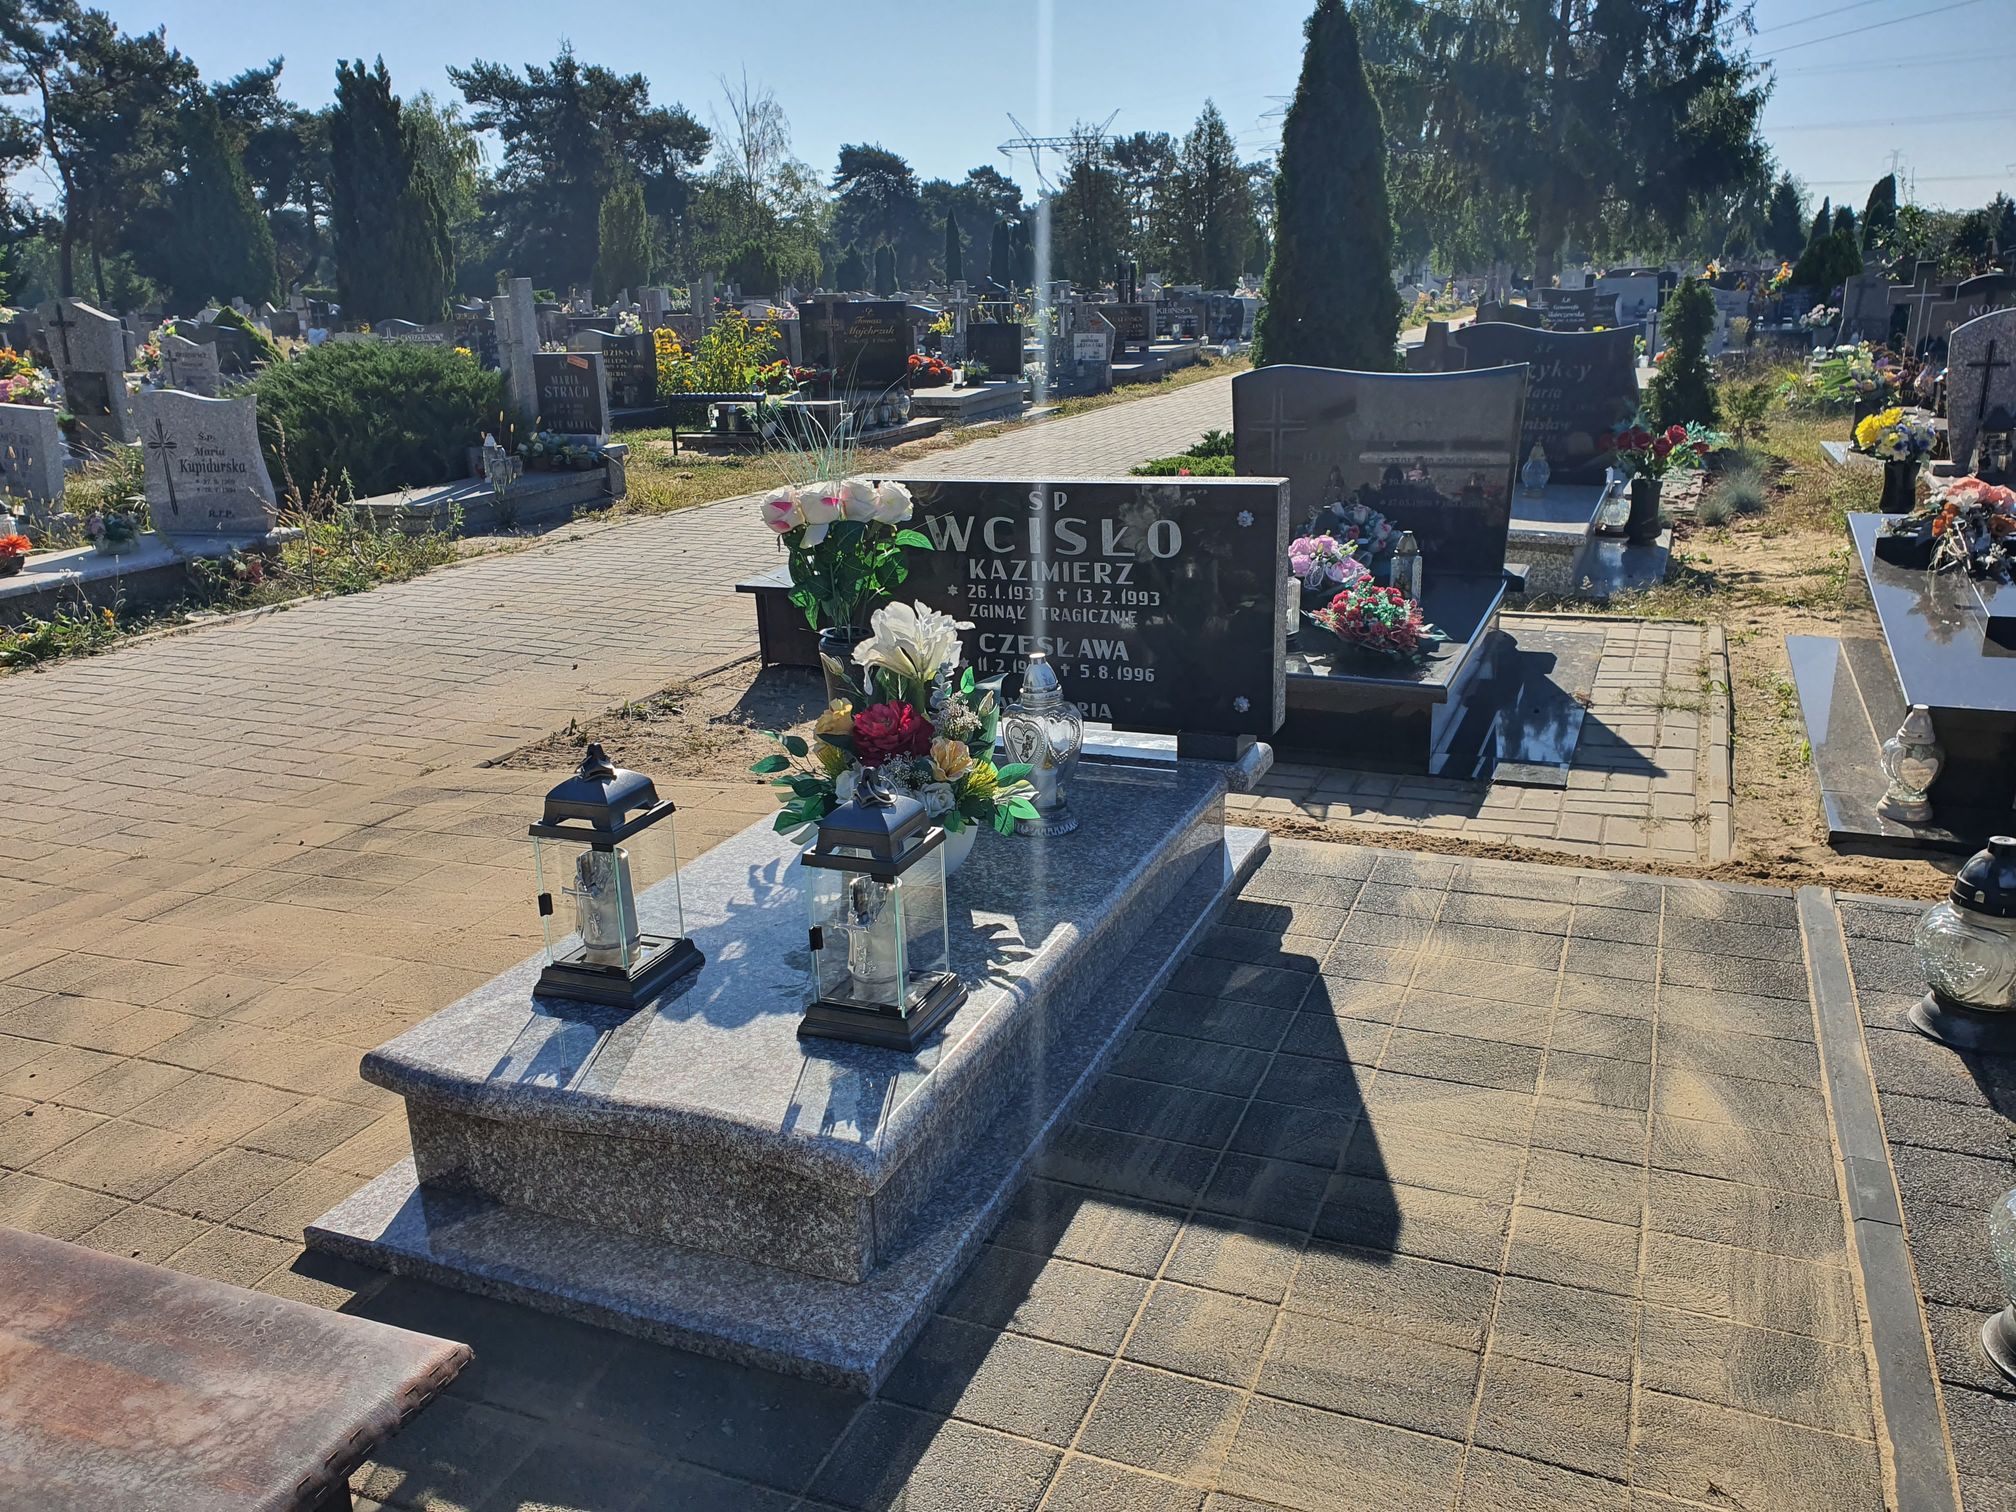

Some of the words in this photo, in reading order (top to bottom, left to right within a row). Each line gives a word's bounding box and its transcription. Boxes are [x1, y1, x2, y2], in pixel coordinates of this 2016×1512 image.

[551, 375, 579, 385] MARIA
[924, 514, 1183, 559] WCISŁO
[968, 558, 1135, 586] KAZIMIERZ
[967, 584, 1045, 601] 26.1.1933
[1077, 587, 1160, 606] 13.2.1993
[969, 603, 1027, 624] ZGINĄŁ
[1039, 606, 1138, 625] TRAGICZNIE
[979, 632, 1130, 661] CZESŁAWA
[978, 656, 1028, 674] 11.2.19
[1080, 663, 1155, 682] 5.8.1996
[1077, 701, 1113, 719] RIA
